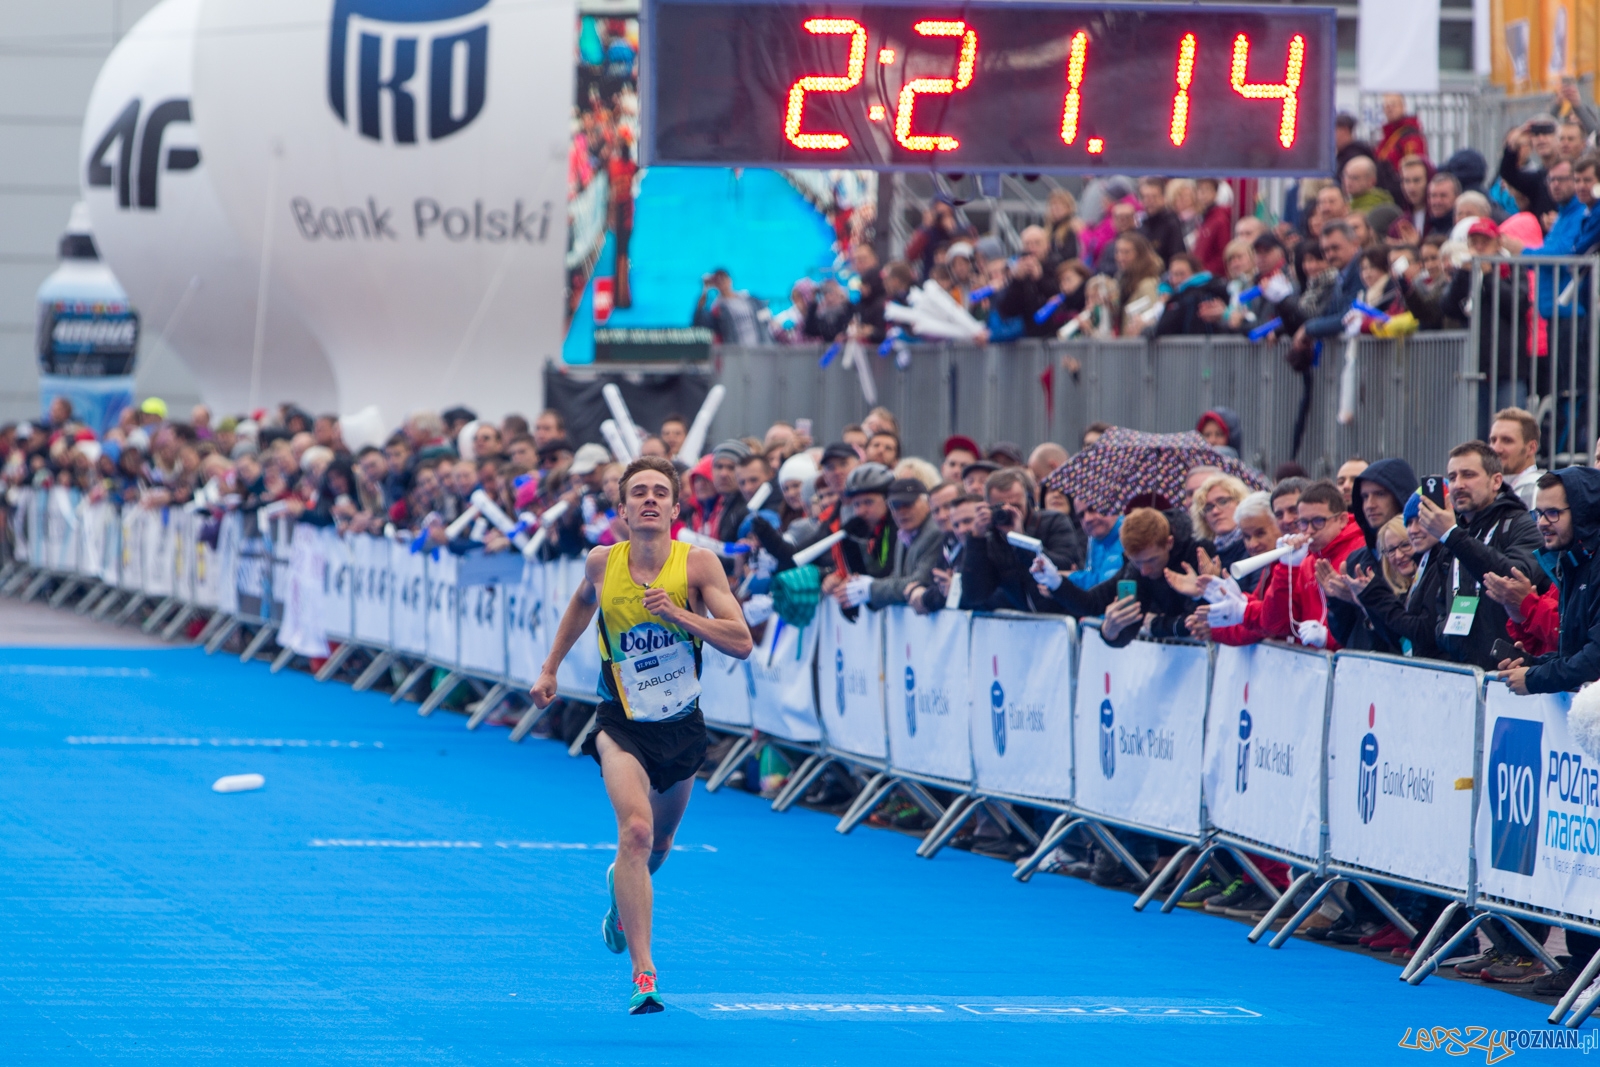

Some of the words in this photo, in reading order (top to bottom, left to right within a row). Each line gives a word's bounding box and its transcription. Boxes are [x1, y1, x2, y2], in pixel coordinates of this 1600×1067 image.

[87, 97, 203, 211] 4F
[290, 196, 397, 241] Bank
[413, 197, 554, 244] Polski
[620, 629, 681, 652] Volvic
[1119, 725, 1146, 757] Bank
[1147, 728, 1175, 761] Polski
[1382, 761, 1406, 798] Bank
[1406, 765, 1435, 804] Polski
[1497, 762, 1535, 827] PKO
[1544, 805, 1600, 857] marato
